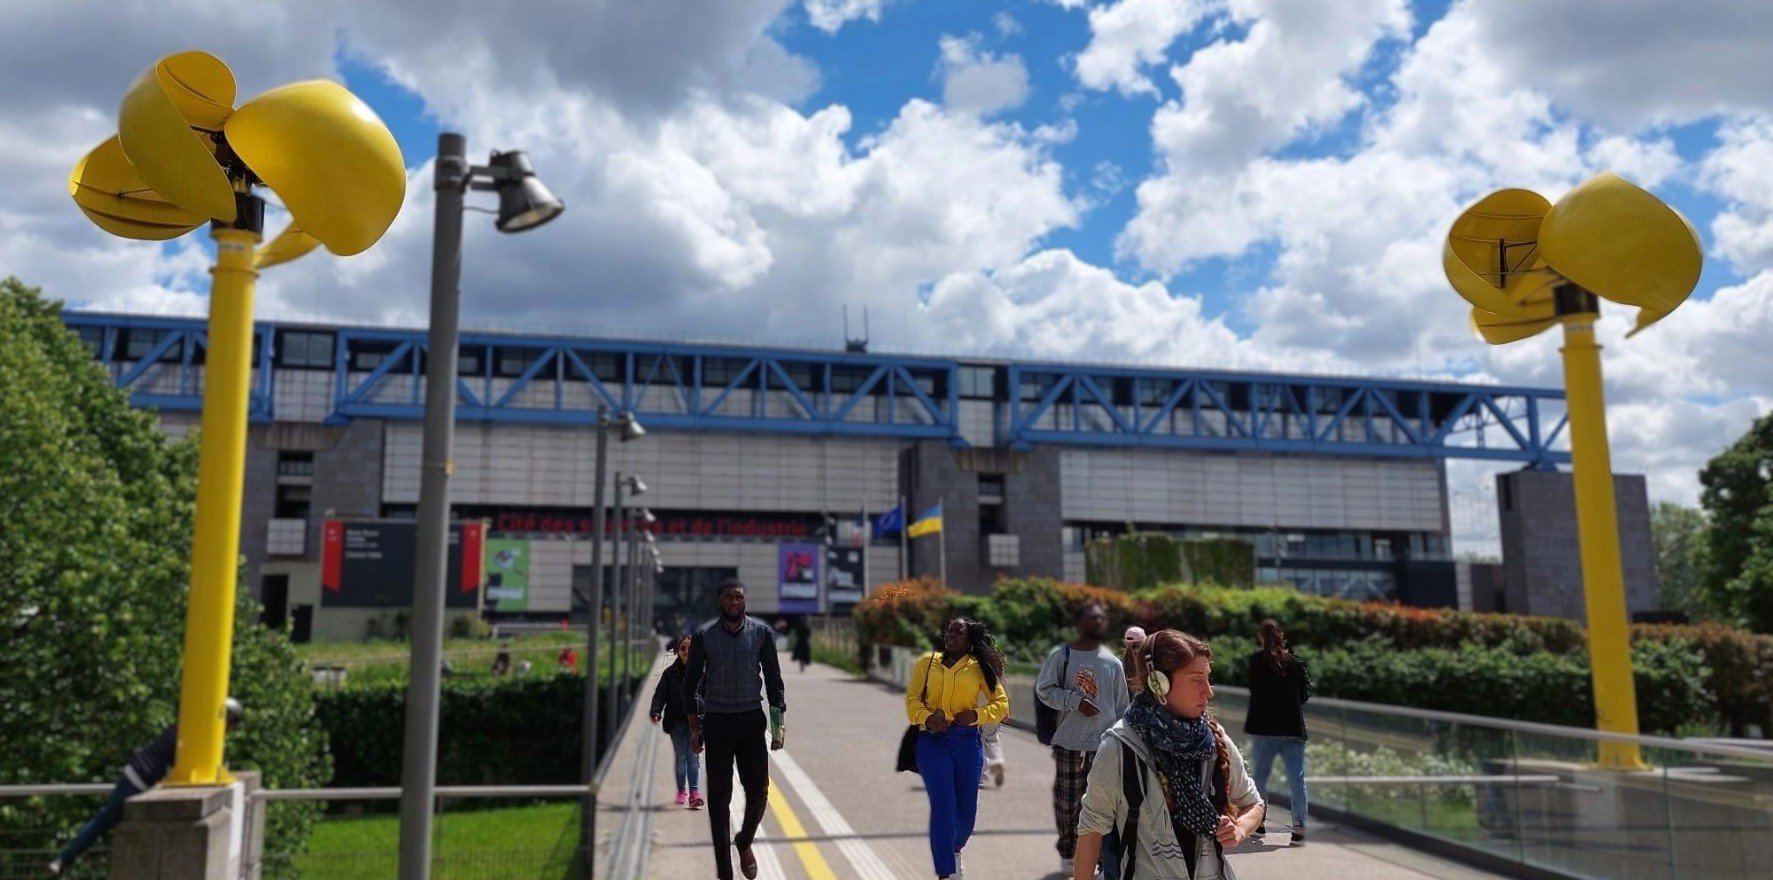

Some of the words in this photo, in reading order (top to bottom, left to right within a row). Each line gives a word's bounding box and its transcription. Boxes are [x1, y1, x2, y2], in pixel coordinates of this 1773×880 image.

[497, 509, 536, 532] Cité
[541, 512, 575, 532] des
[577, 516, 663, 536] senes
[667, 516, 687, 536] et
[690, 516, 713, 536] de
[716, 517, 807, 538] l'industrie
